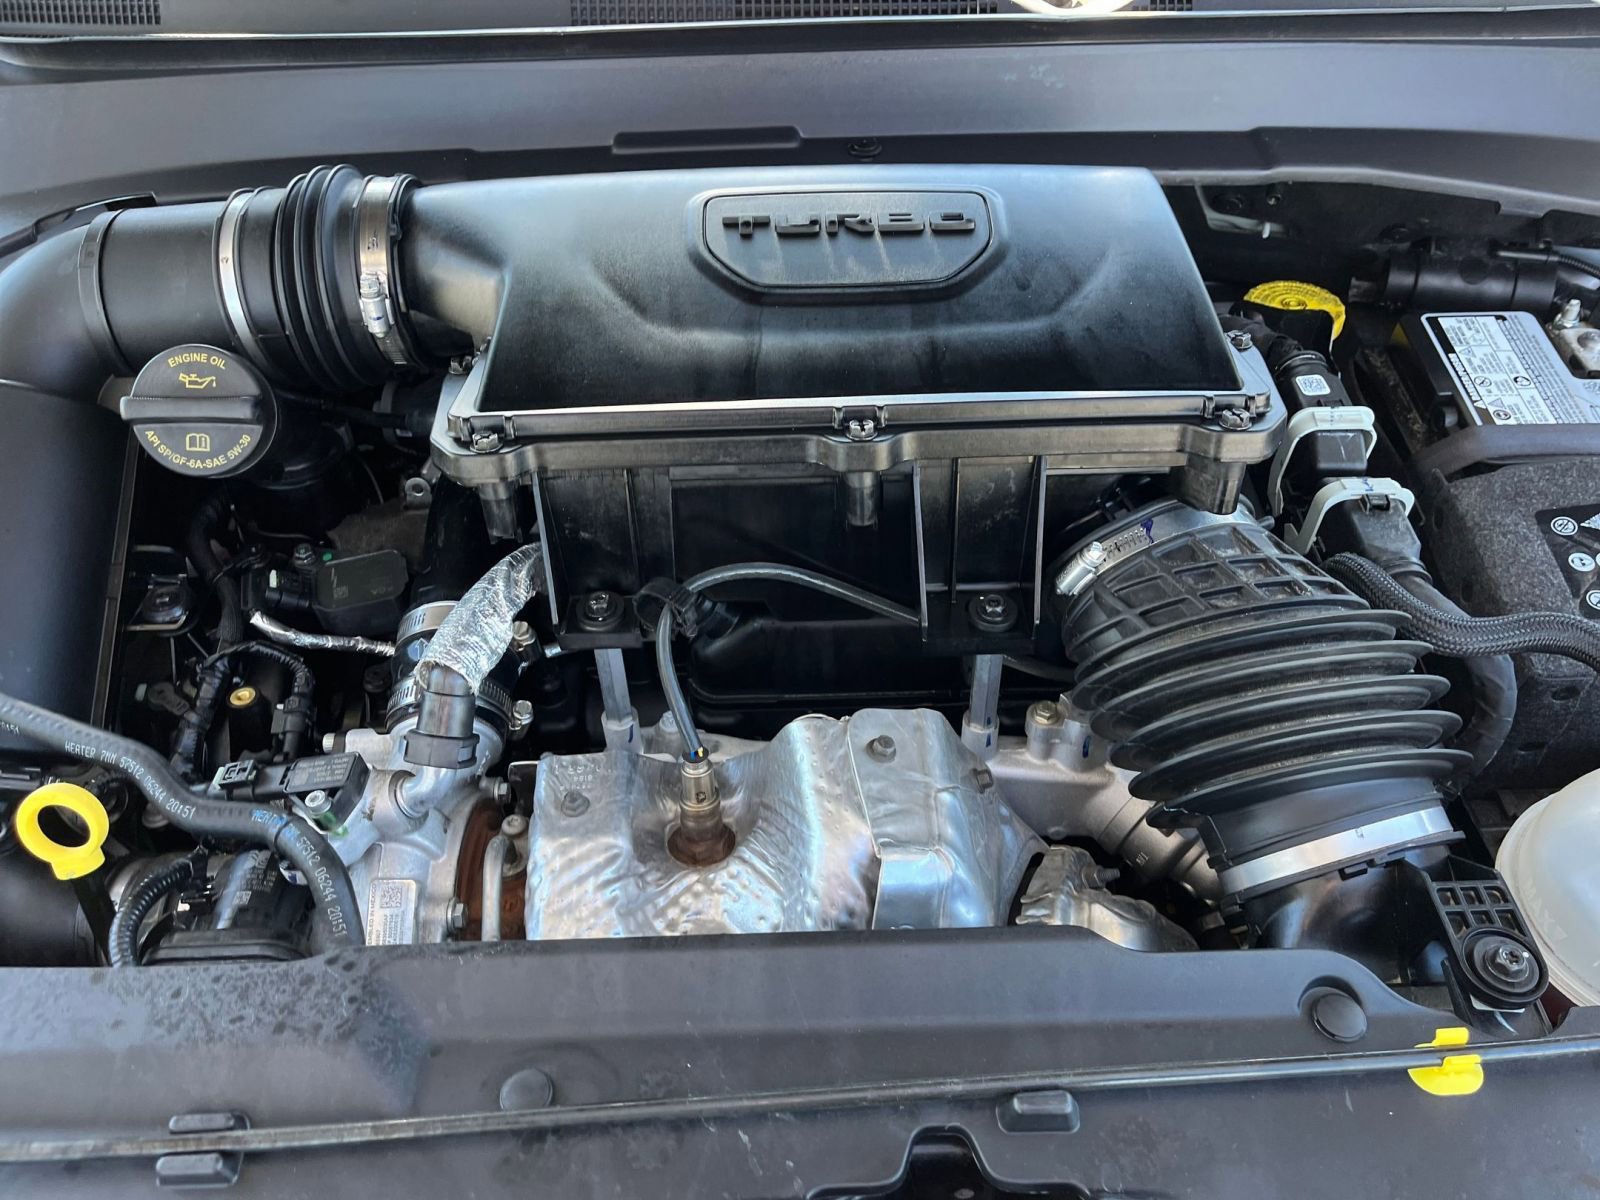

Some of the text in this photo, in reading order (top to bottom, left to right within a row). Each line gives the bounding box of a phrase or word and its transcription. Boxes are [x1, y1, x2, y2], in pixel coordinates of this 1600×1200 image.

[722, 212, 976, 235] TURBO
[168, 353, 226, 369] ENGINE OIL
[145, 430, 251, 469] API SP/GF-6A-SAE 5W-30
[64, 740, 96, 760] HEATER
[119, 756, 145, 780] 57512
[143, 776, 167, 803] 06244
[296, 836, 320, 866] 57512
[315, 868, 337, 903] 06244
